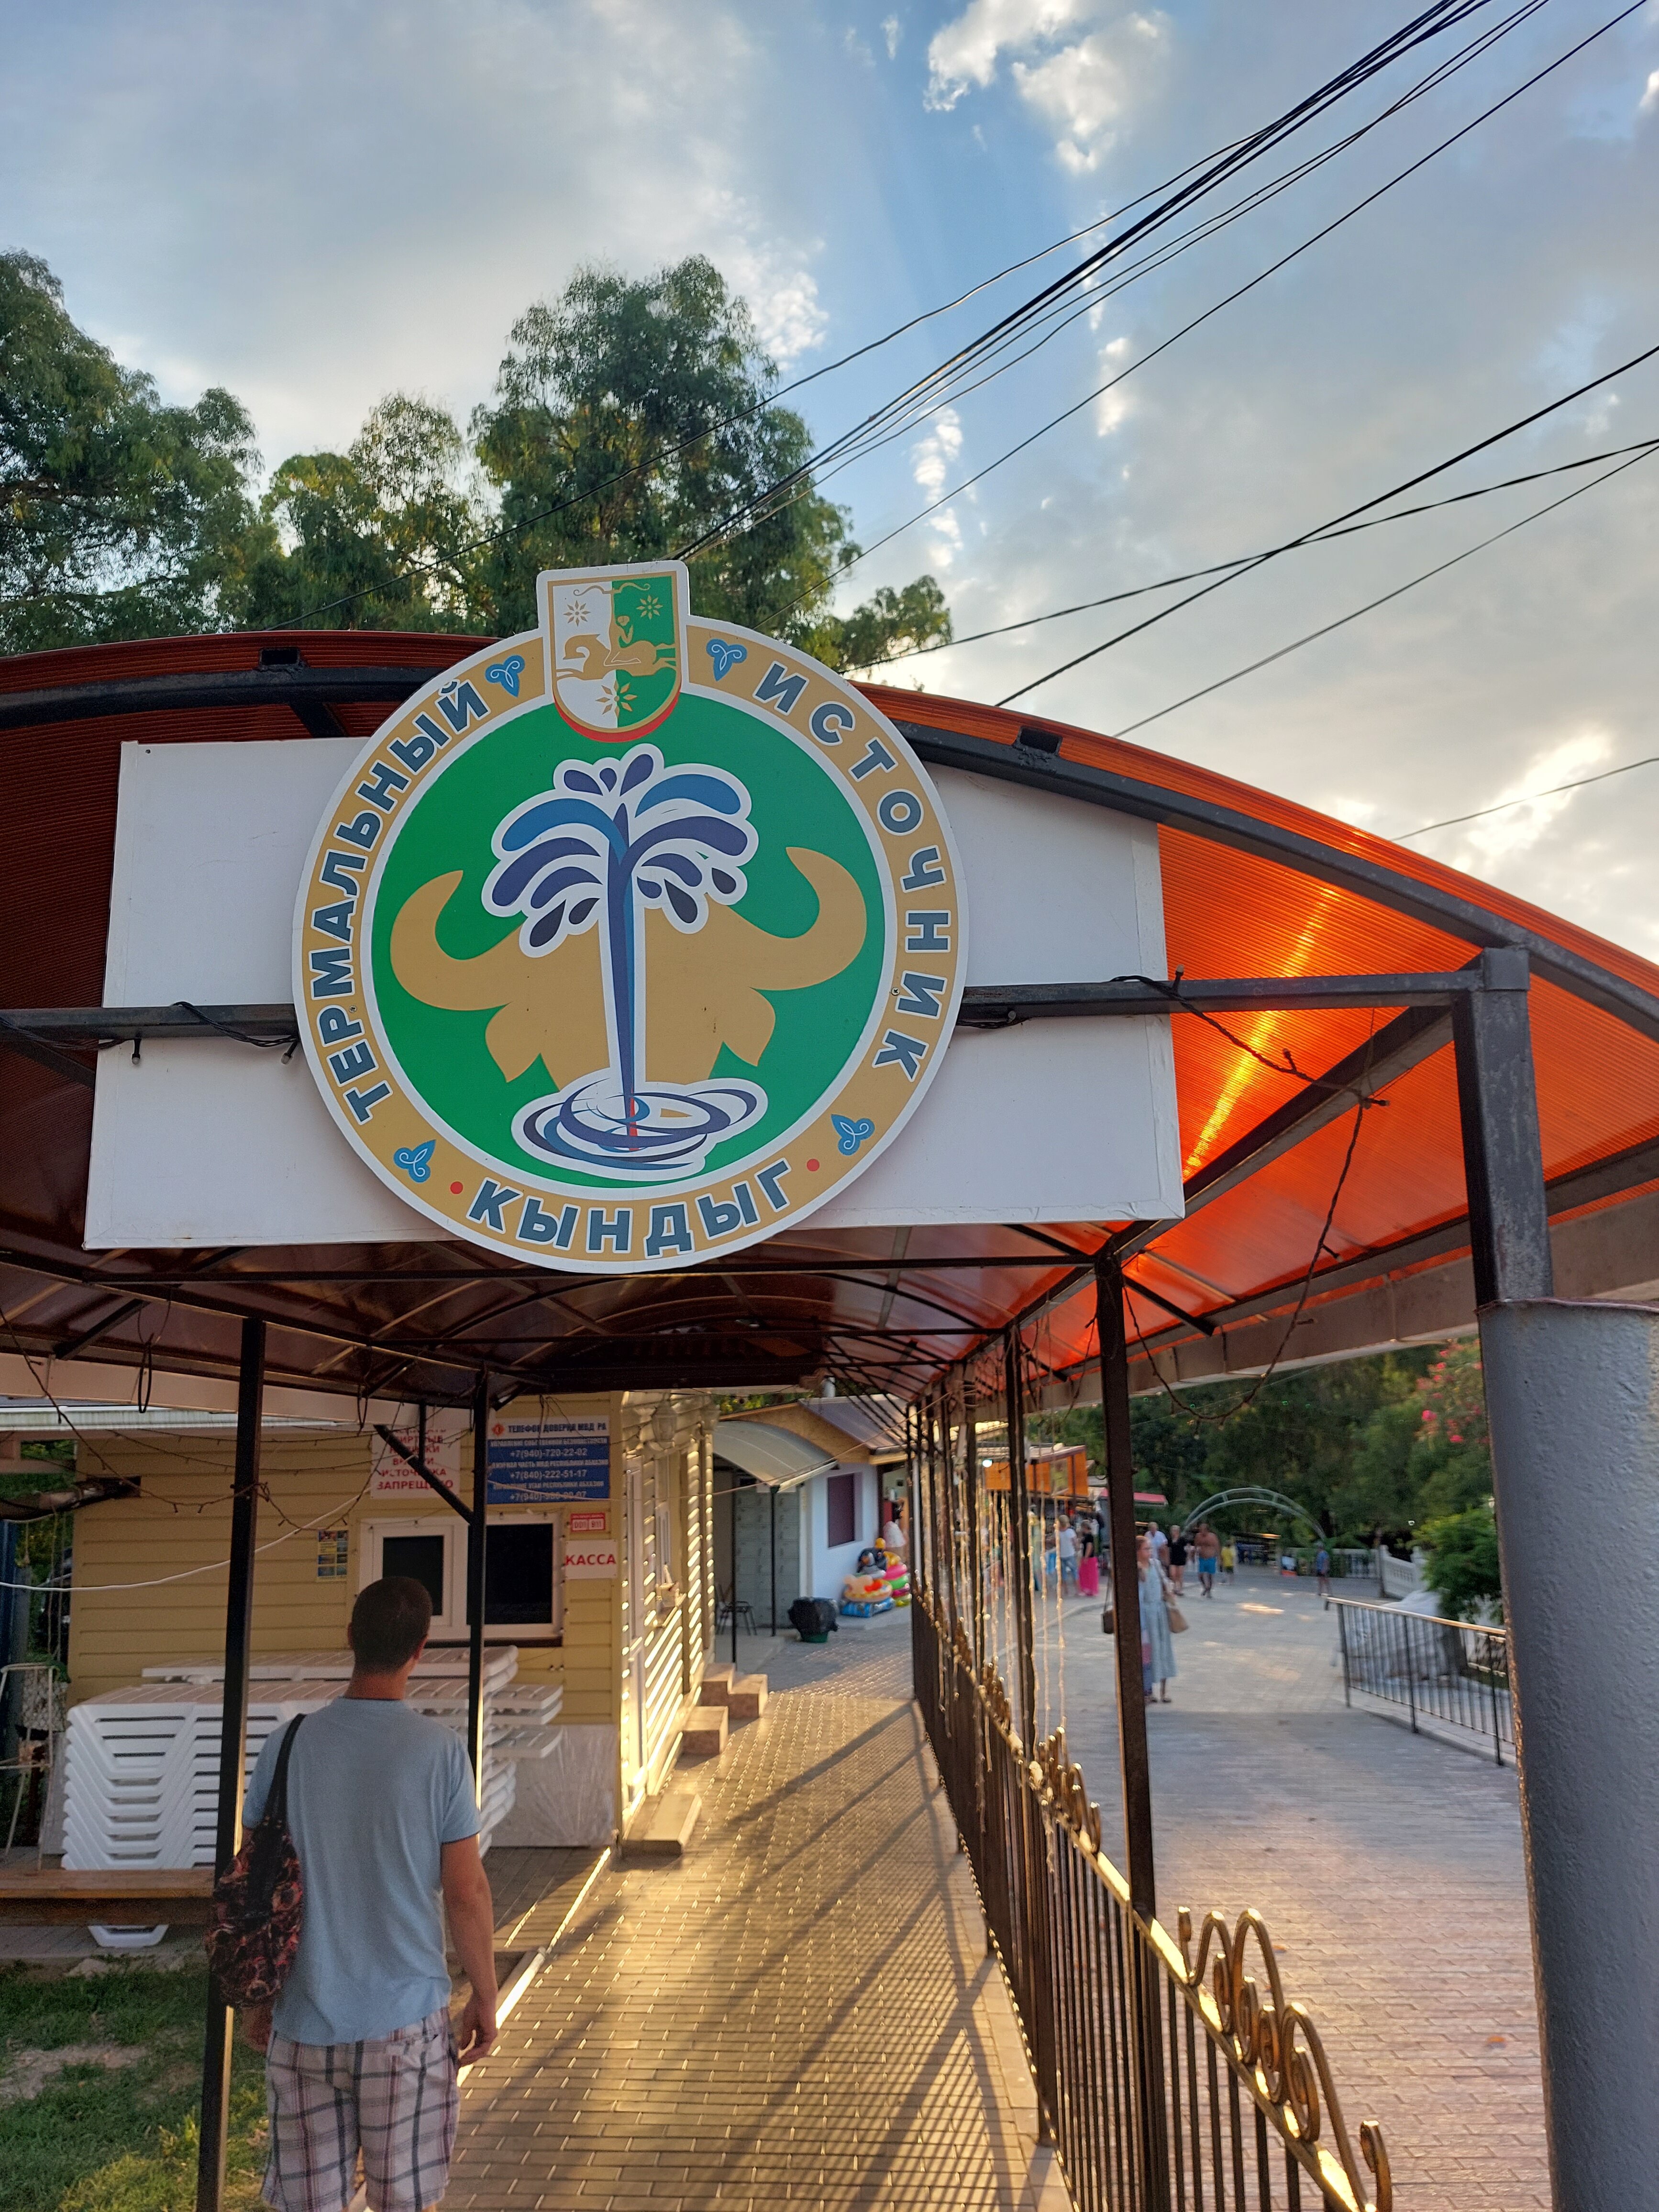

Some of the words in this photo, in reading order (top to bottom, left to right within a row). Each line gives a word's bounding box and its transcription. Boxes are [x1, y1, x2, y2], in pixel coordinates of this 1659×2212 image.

[311, 679, 487, 1121] ТЕРМАЛЬНЫЙ
[757, 664, 948, 1078] ИСТОЧНИК
[470, 1161, 789, 1257] КЫНДЫГ
[377, 1480, 453, 1490] ЗАПРЕЩО
[566, 1554, 616, 1565] КАССА
